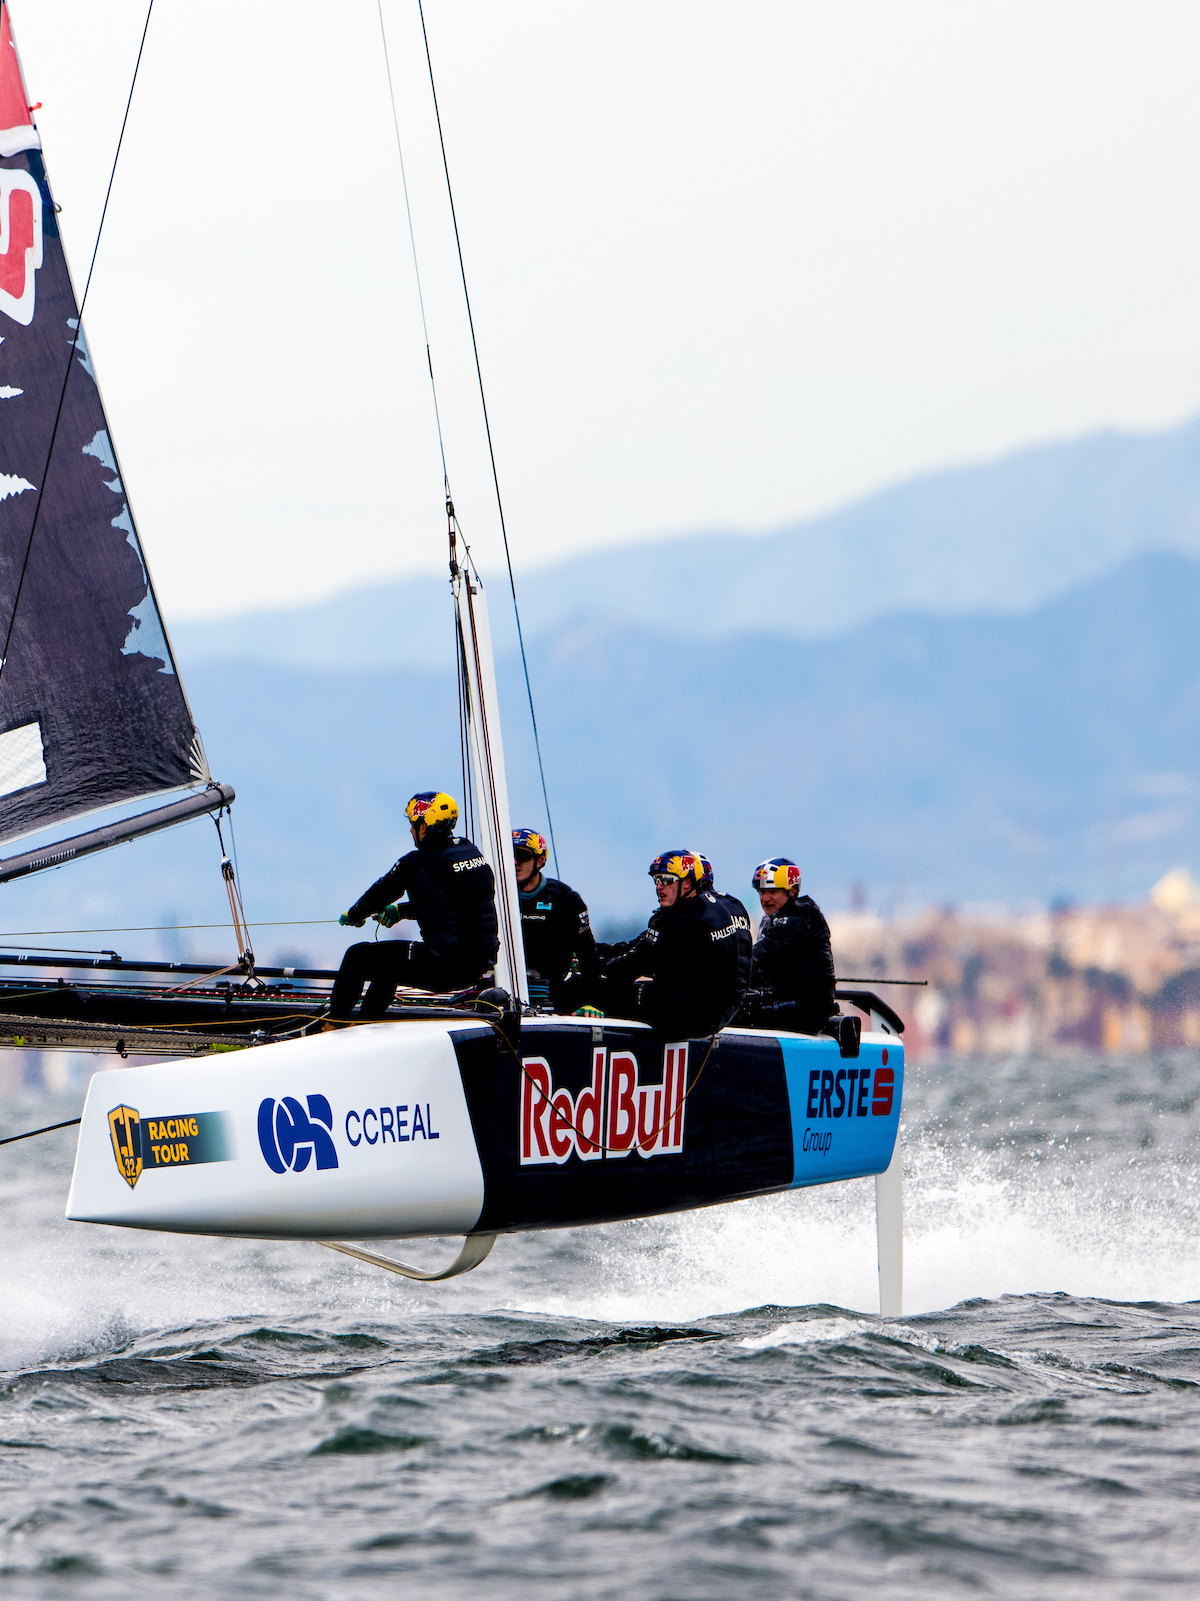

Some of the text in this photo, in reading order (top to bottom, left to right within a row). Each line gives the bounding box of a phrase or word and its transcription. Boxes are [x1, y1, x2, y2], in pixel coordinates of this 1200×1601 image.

[806, 1069, 870, 1118] ERSTE
[148, 1117, 199, 1141] RACING
[345, 1103, 440, 1147] CCREAL
[151, 1143, 190, 1164] TOUR
[802, 1127, 832, 1156] Group
[124, 1158, 137, 1177] 32
